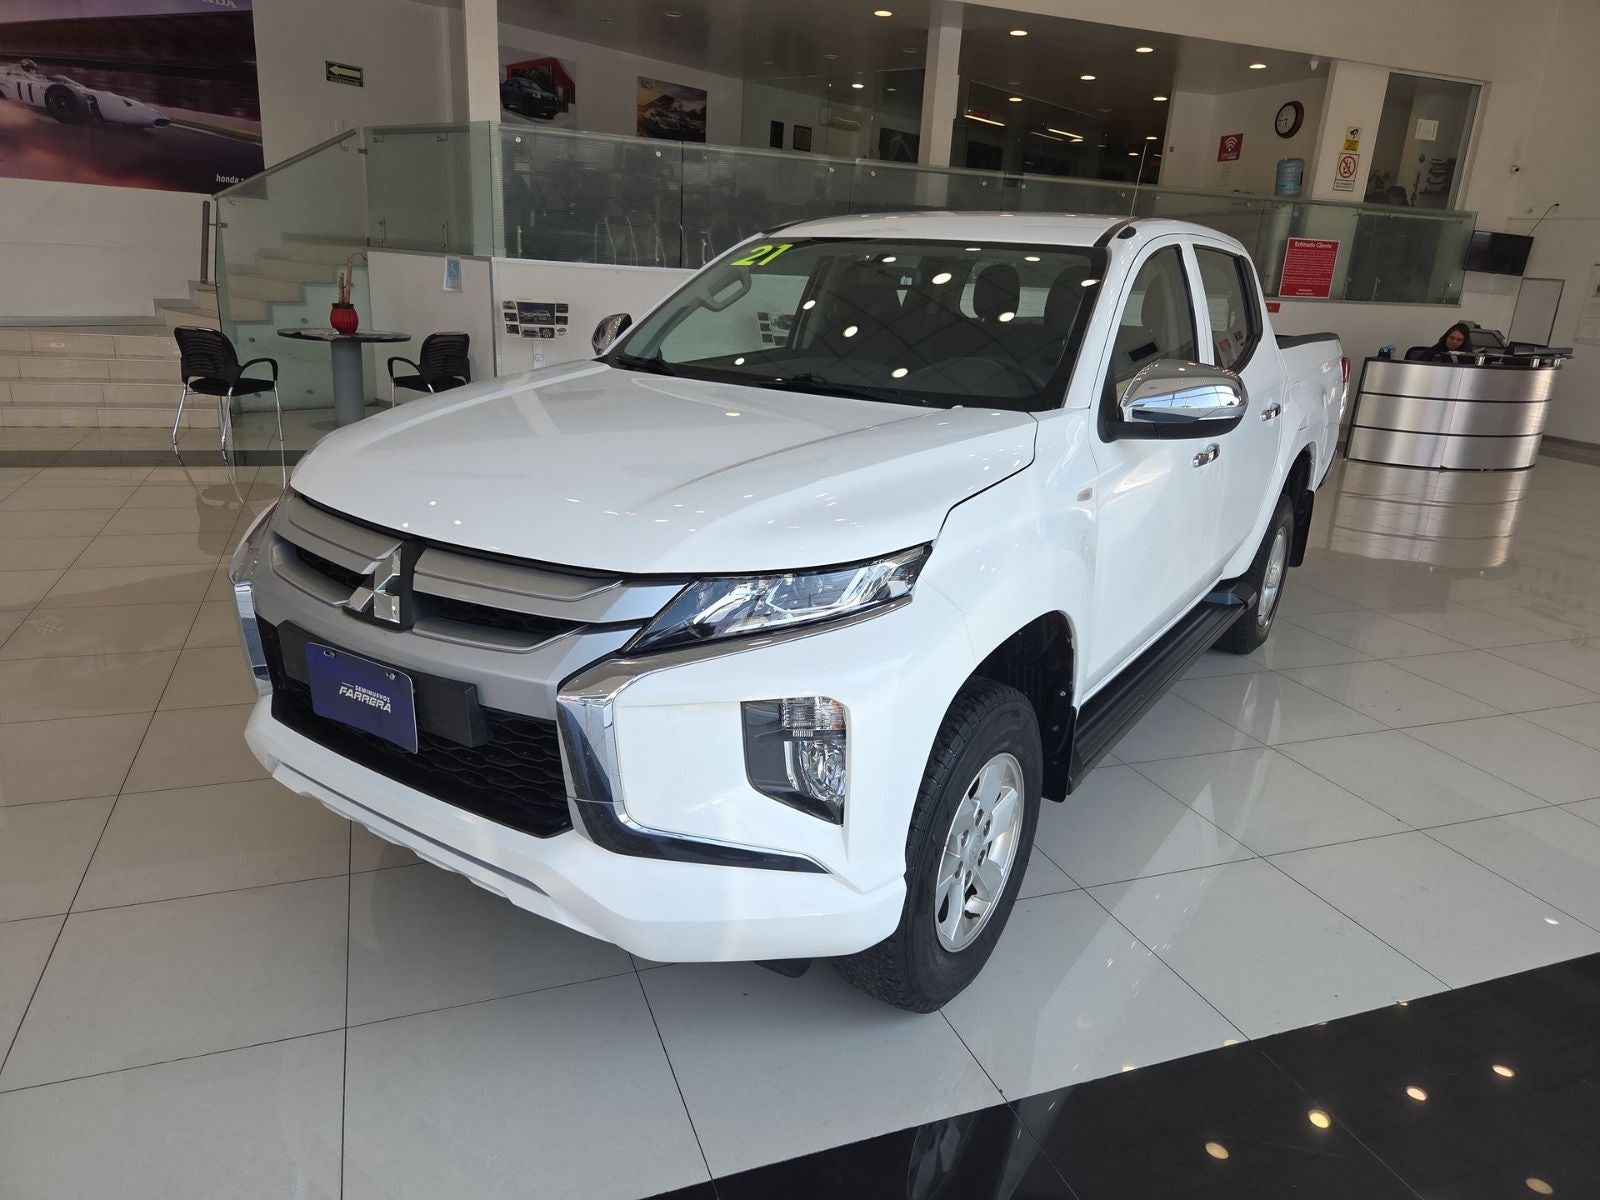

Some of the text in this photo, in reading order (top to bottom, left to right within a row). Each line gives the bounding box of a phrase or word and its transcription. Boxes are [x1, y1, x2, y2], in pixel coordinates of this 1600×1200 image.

[730, 244, 794, 266] 21
[339, 686, 392, 713] FARRERA
[355, 685, 391, 703] SEMINUEVOS
